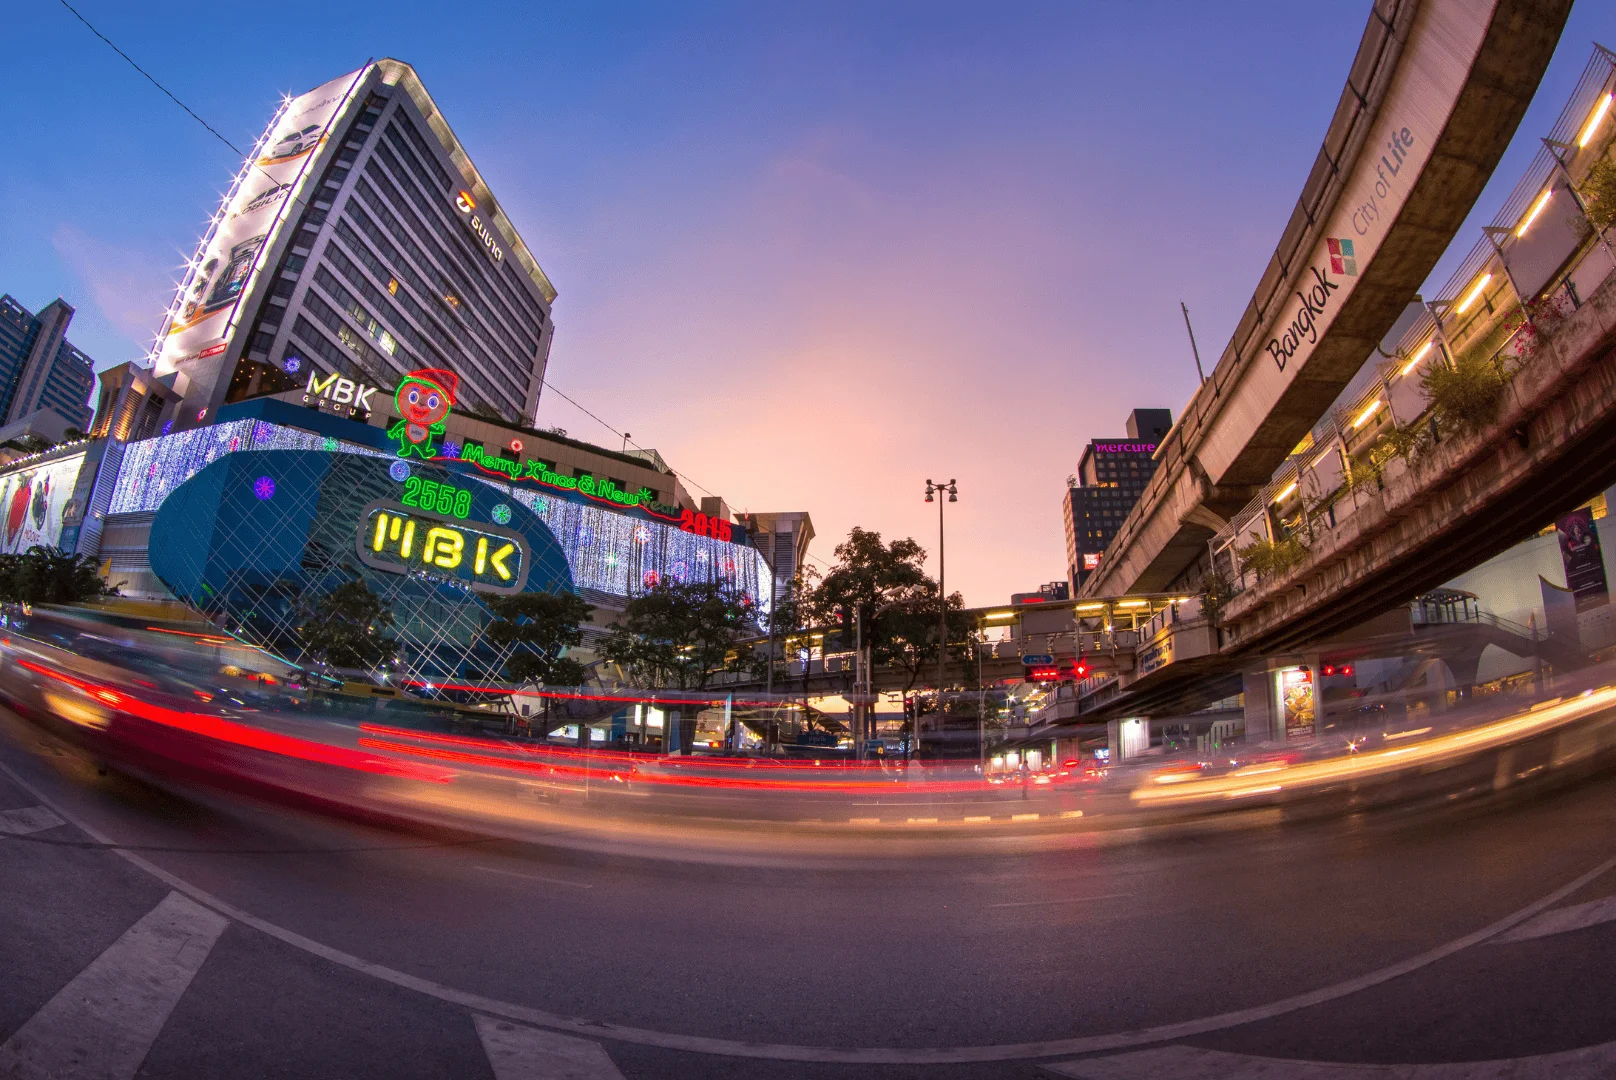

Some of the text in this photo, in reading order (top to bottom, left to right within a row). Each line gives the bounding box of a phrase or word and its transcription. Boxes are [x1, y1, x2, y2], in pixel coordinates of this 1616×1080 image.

[1352, 126, 1415, 237] City of Life
[1265, 266, 1339, 373] Bangkok
[302, 394, 372, 419] GROUP
[305, 369, 378, 412] MBK
[1095, 443, 1155, 453] mercure
[461, 443, 523, 481] Merry
[525, 459, 577, 489] X'mas
[577, 474, 597, 495] &
[598, 479, 639, 506] New
[402, 475, 472, 519] 2558
[372, 512, 515, 581] MBK
[679, 508, 732, 543] 2015
